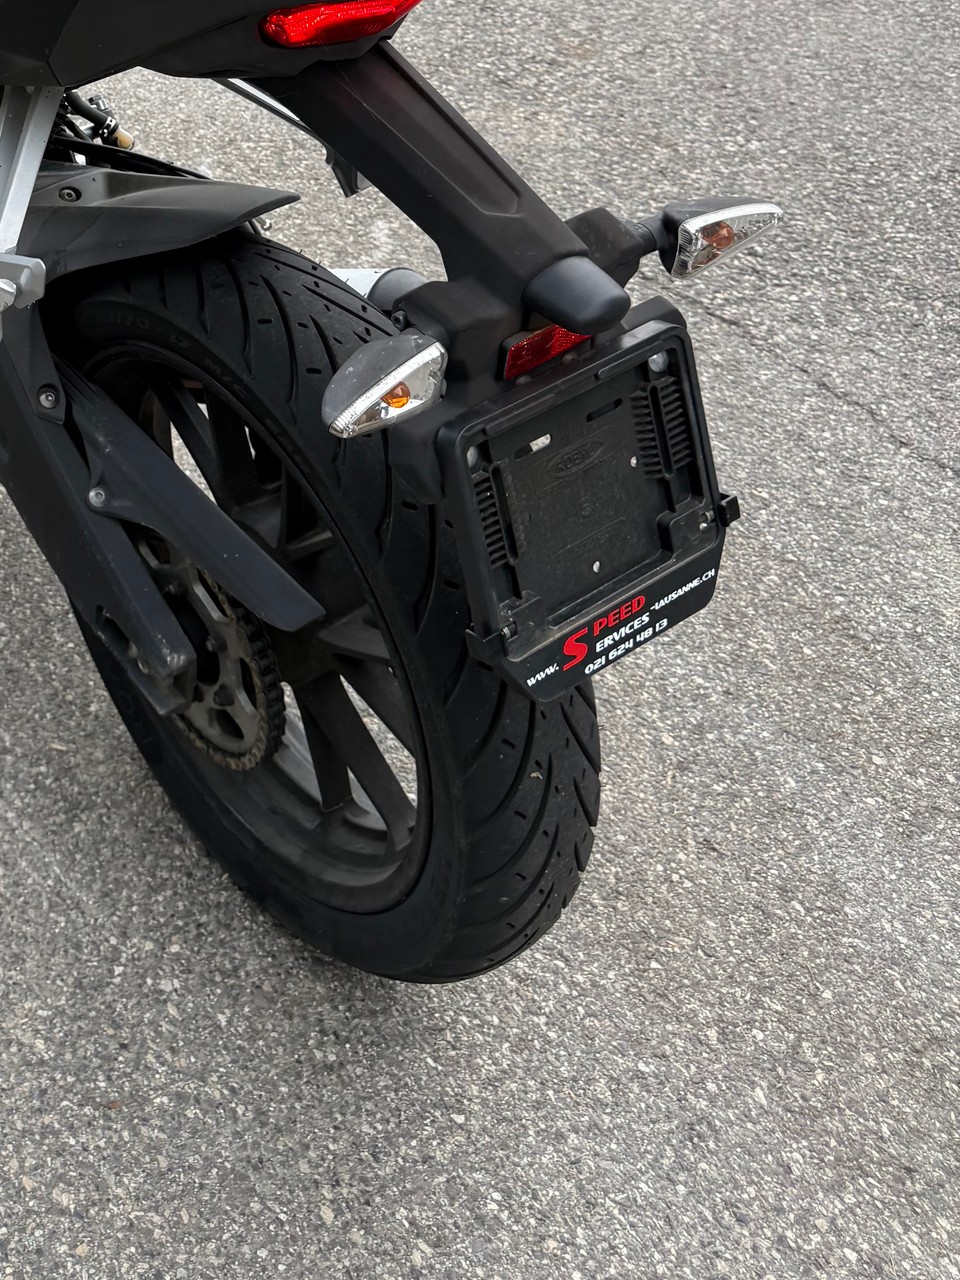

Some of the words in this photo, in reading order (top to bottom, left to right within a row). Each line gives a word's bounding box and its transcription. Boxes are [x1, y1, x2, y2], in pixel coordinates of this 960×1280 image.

[584, 656, 606, 675] 021
[608, 641, 634, 660] 624
[655, 618, 668, 633] 13
[526, 663, 559, 686] www.
